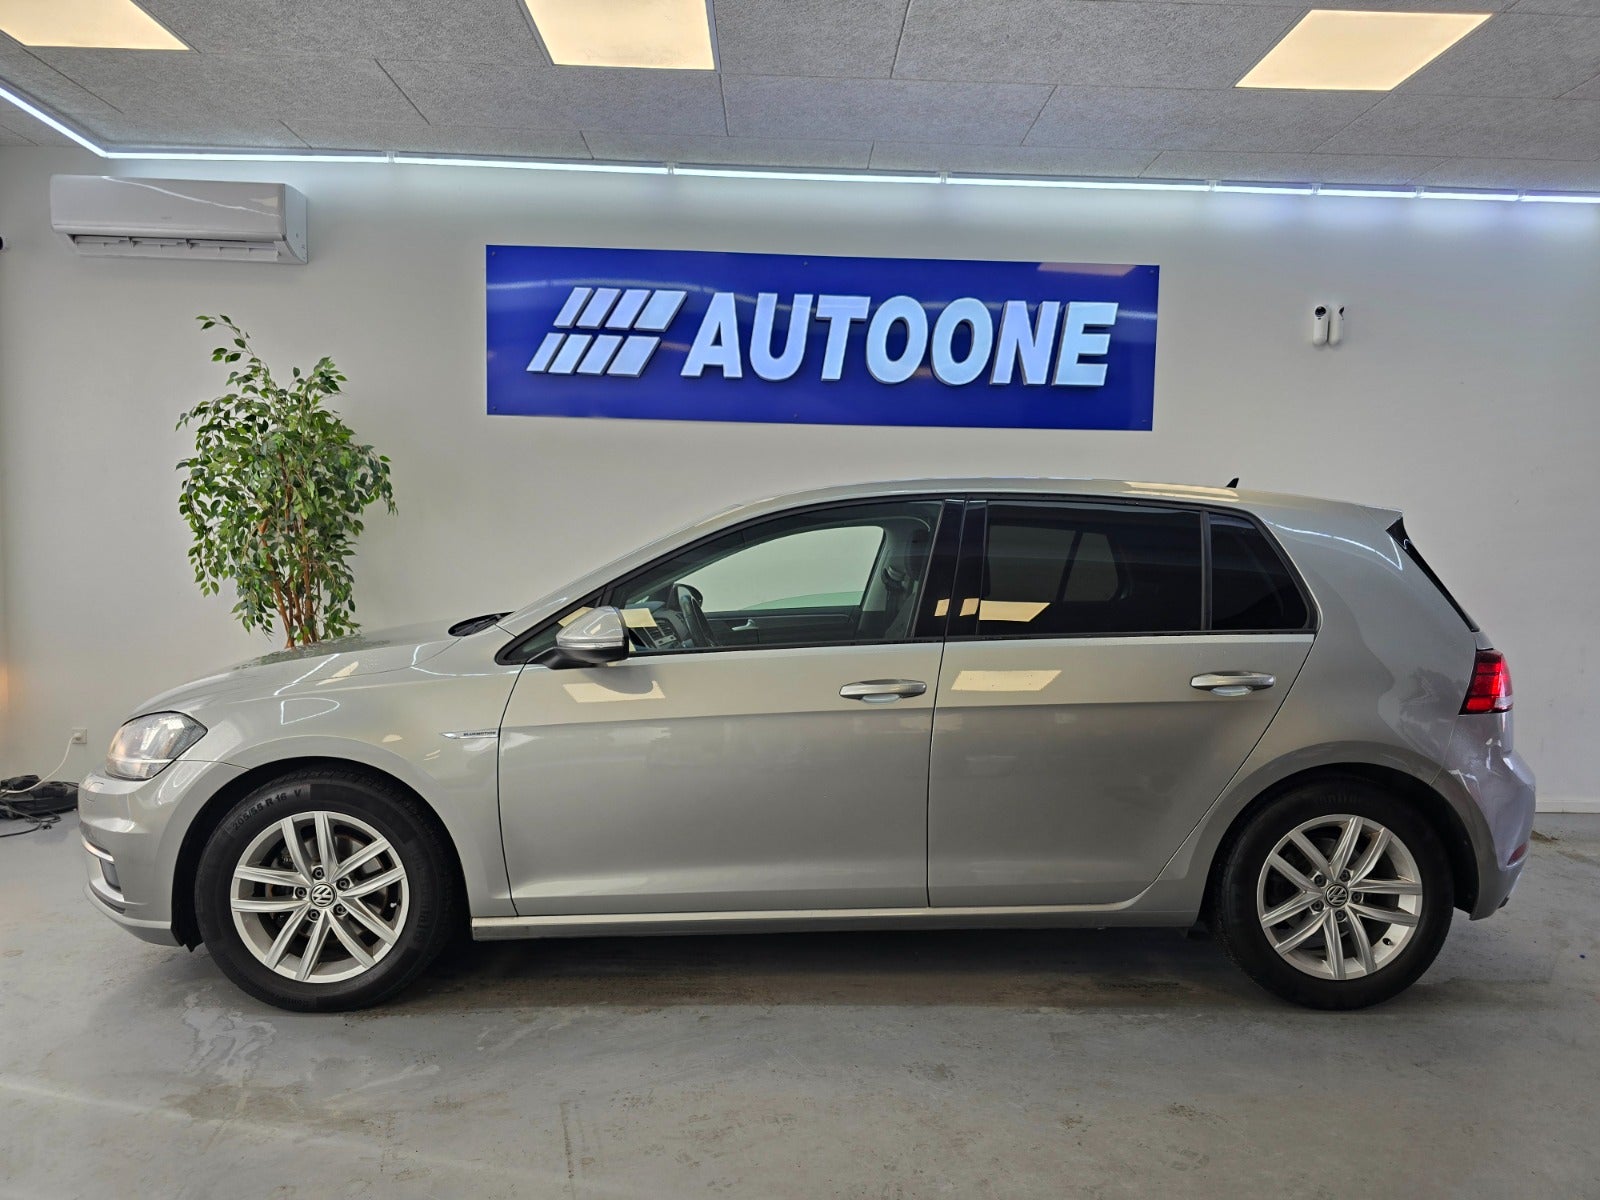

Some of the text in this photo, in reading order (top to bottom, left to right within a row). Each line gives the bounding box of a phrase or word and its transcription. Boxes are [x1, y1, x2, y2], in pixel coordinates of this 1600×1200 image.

[680, 292, 1119, 387] AUTOONE
[231, 788, 302, 832] 205/55 R 16 V
